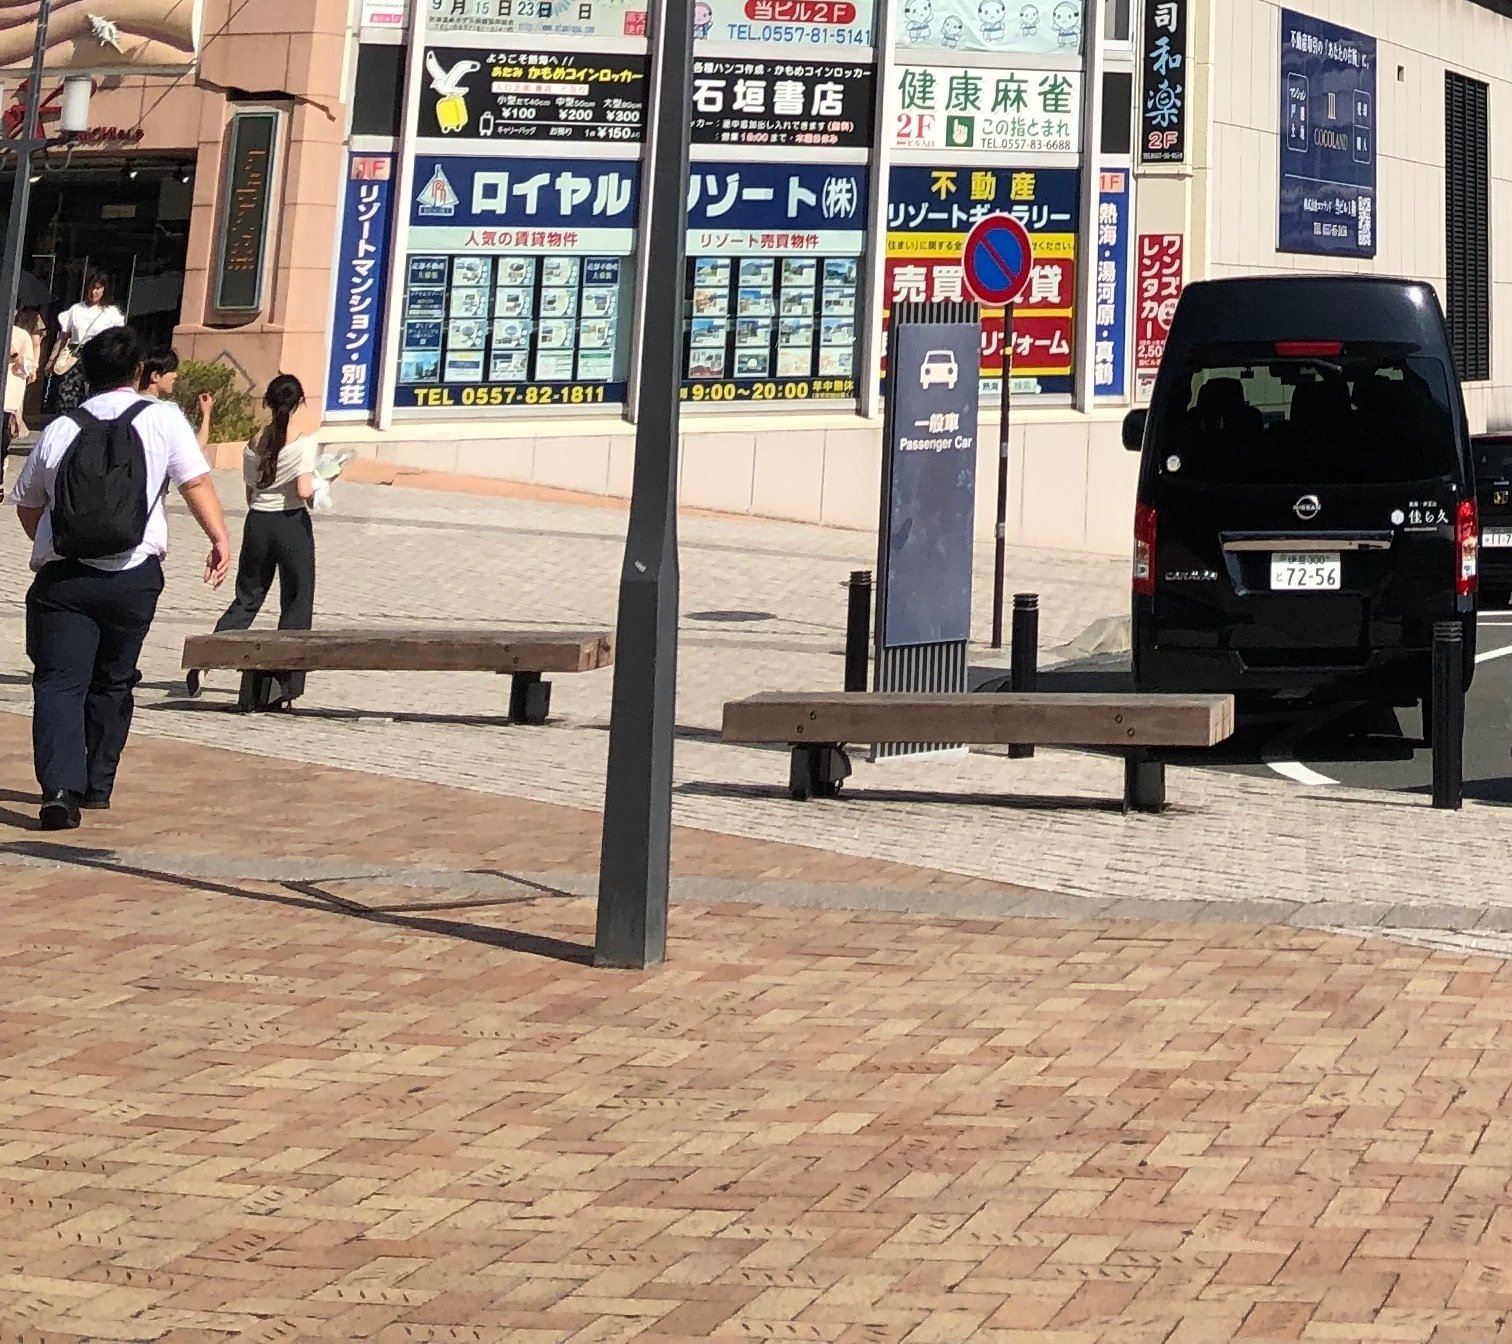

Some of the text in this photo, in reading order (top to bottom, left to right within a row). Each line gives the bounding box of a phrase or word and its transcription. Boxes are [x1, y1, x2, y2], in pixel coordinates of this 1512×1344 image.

[754, 0, 848, 24] 当ビル2F
[727, 23, 872, 46] TEL.0557-81-5141
[490, 66, 644, 83] あたみ かもめコインロッカー
[692, 78, 845, 117] 石垣書店
[898, 68, 1074, 114] 健康麻雀
[501, 107, 537, 120] ¥100
[558, 109, 594, 122] ¥200
[896, 113, 936, 139] 2F
[981, 118, 1071, 138] この指とまれ
[1147, 131, 1179, 149] 2F
[471, 171, 632, 216] ロイヤル
[930, 170, 1036, 201] 不動産
[1100, 174, 1120, 191] 1F
[887, 202, 1072, 229] リゾートギラリー
[464, 230, 820, 250] 人気の賃貸物件 リゾート売買物件
[1161, 234, 1182, 297] ワンズ
[337, 183, 380, 405] リゾートマンション・別荘
[892, 263, 965, 303] 売買
[1094, 201, 1119, 388] 熱海・湯河原・真鶴
[1141, 236, 1160, 340] レンタカー
[413, 385, 605, 406] TEL 0557-82-1811
[914, 412, 960, 434] 一般車
[900, 435, 973, 452] Passenger Car
[1286, 567, 1337, 587] 72-56
